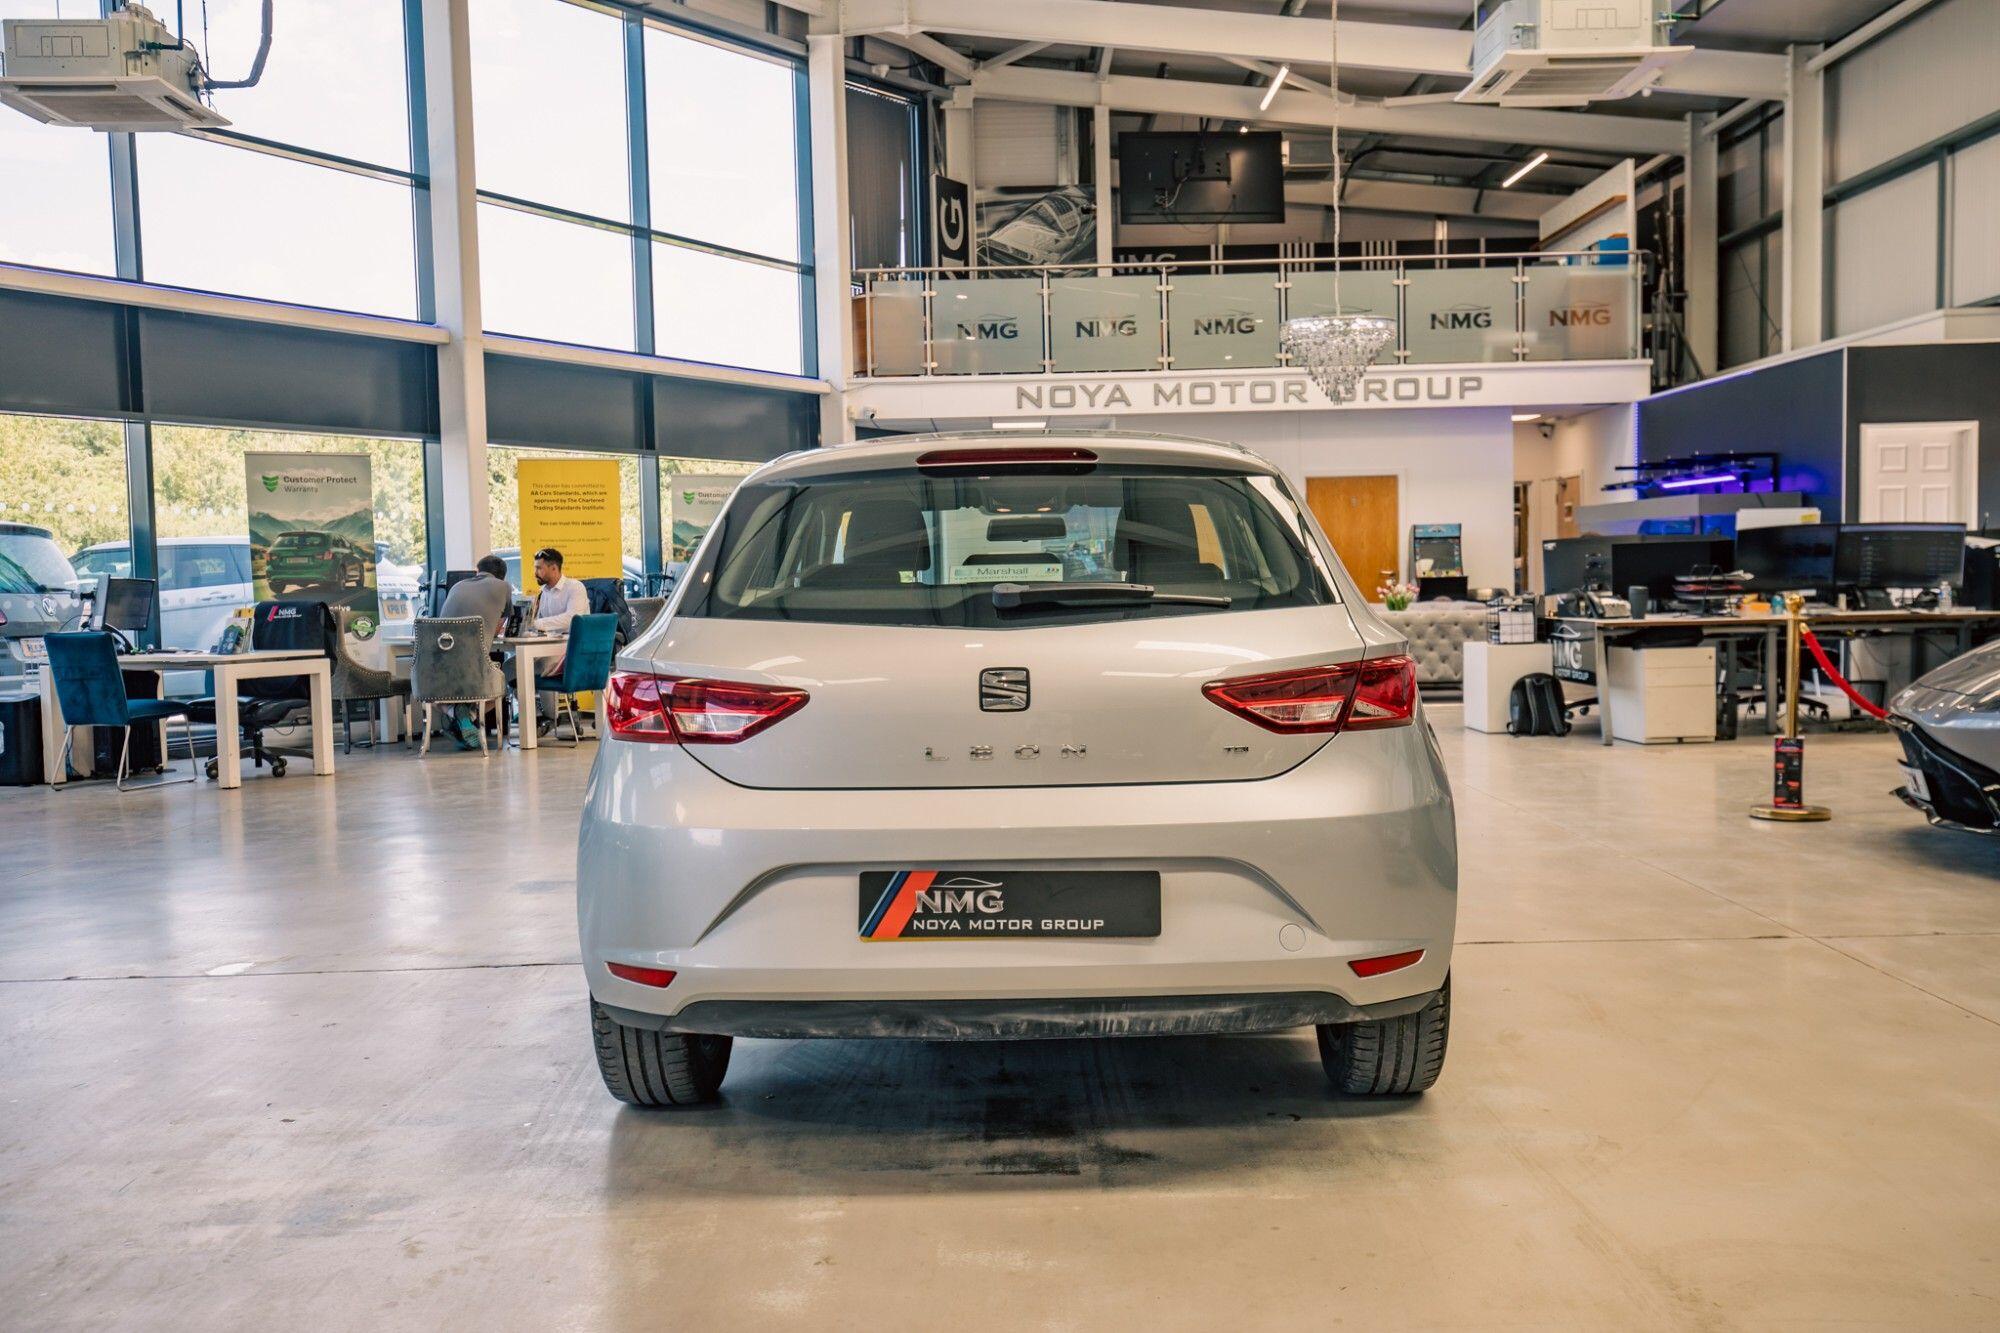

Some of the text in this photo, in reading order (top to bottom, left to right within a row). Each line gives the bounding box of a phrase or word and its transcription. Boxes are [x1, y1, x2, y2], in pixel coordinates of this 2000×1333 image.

[1194, 317, 1256, 336] NMG
[1430, 312, 1492, 330] NMG
[1549, 309, 1611, 327] NMG
[957, 322, 1019, 340] NMG
[1075, 319, 1137, 337] NMG
[1016, 383, 1132, 410] NOYA
[1153, 380, 1309, 406] MOTOR
[283, 475, 357, 484] Customer Protect
[976, 567, 1028, 576] Marshall
[278, 608, 297, 616] NMG
[924, 743, 1088, 761] LEON
[915, 889, 1004, 914] NMG
[912, 919, 1105, 931] NOYA MOTOR GROUP
